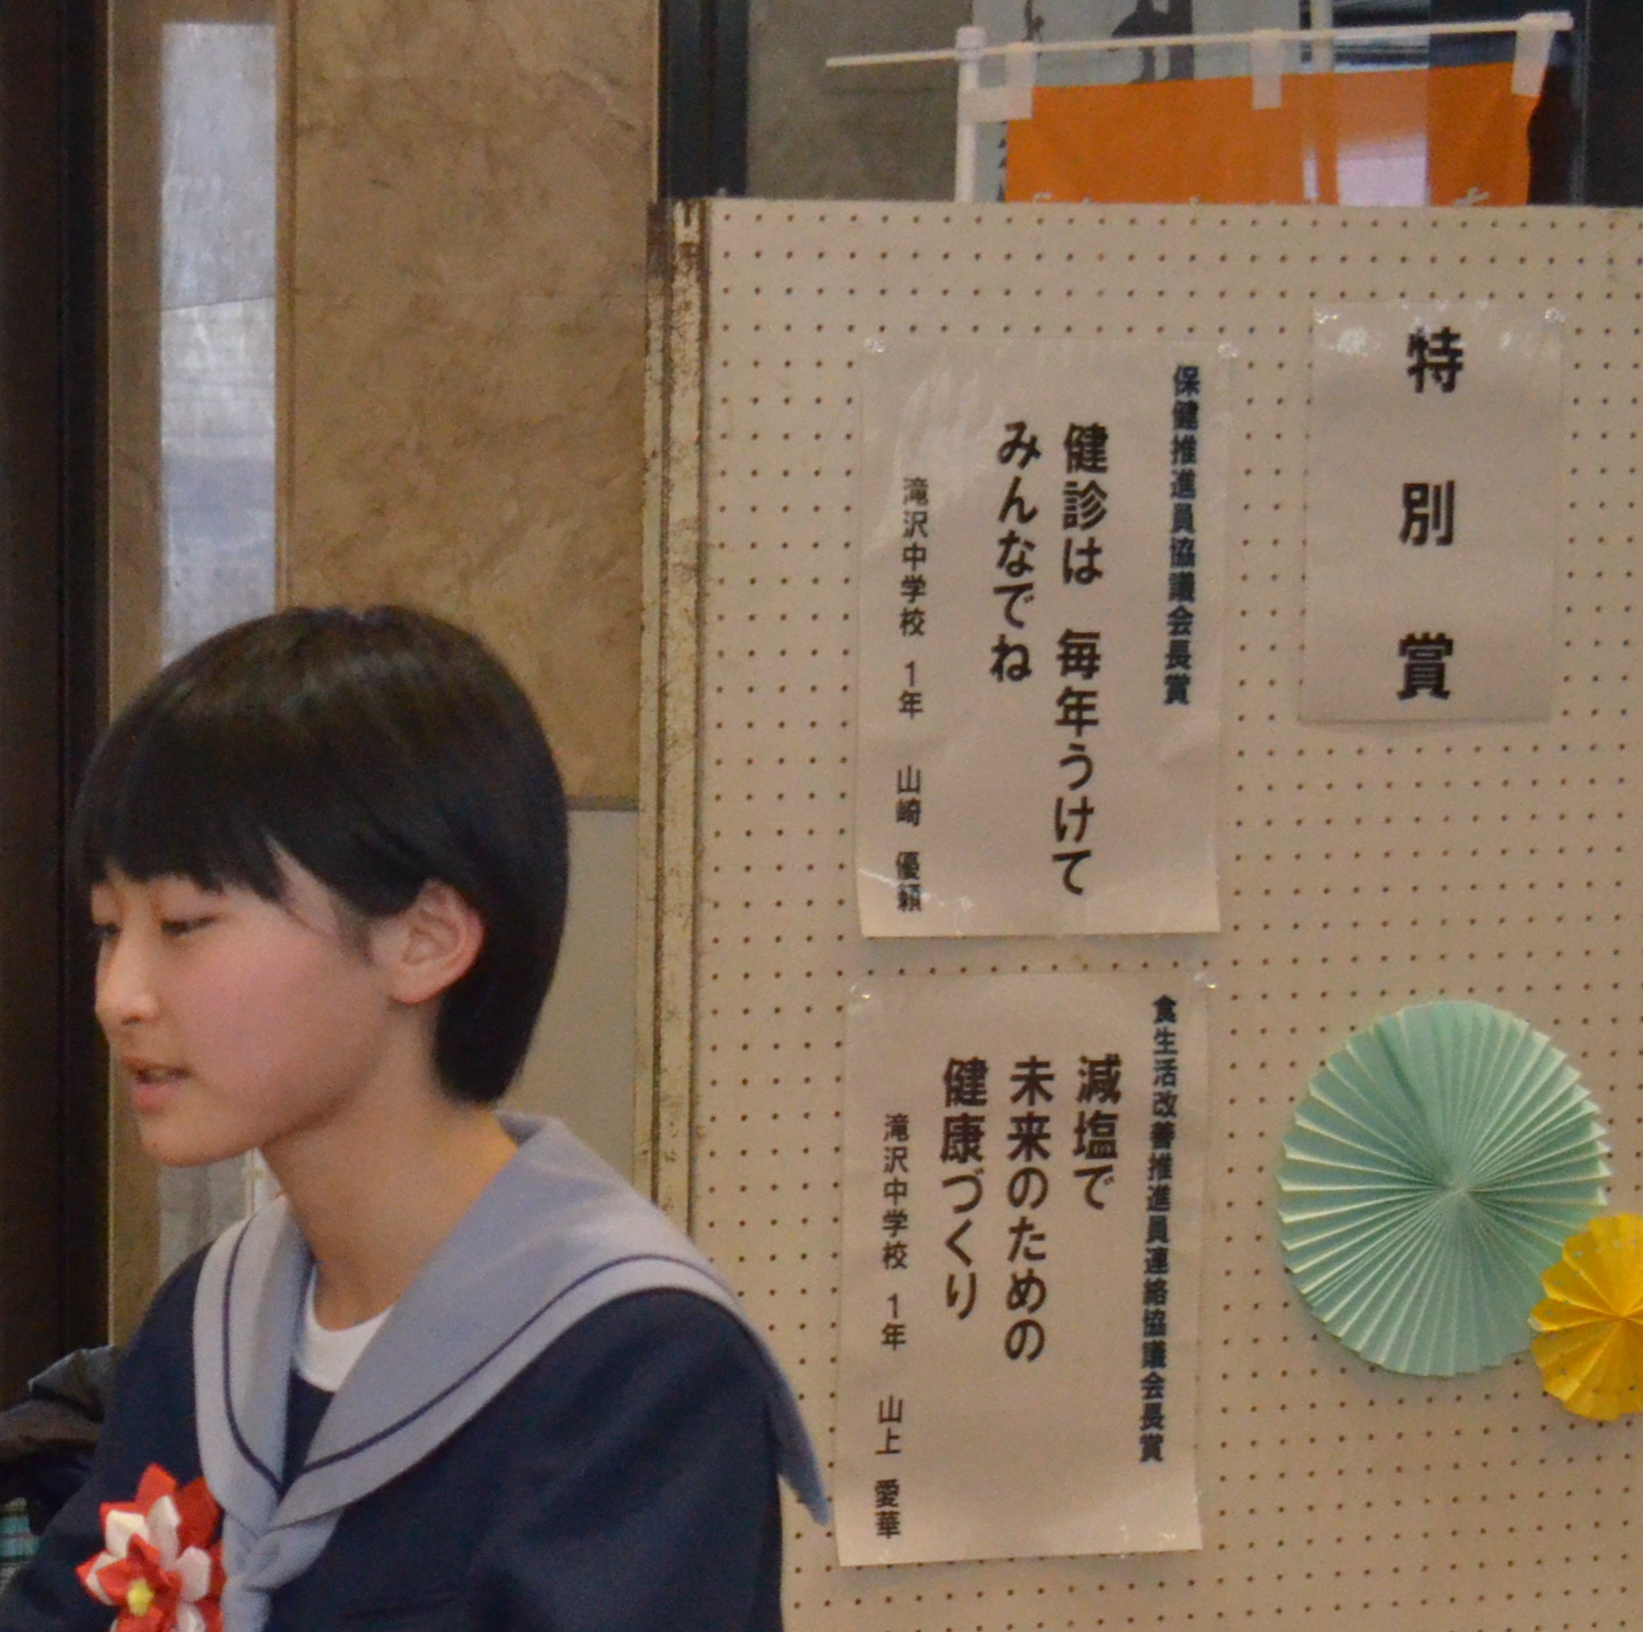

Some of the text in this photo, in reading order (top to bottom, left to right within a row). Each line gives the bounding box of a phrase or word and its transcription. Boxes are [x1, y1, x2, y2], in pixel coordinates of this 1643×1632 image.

[898, 476, 930, 637] 滝沢中学校
[989, 418, 1041, 684] みんなでね
[1050, 421, 1109, 897] 健診は 毎年うけて
[1163, 364, 1202, 707] 保健推進員協議会長賞
[1395, 326, 1465, 703] 特別賞
[898, 659, 925, 721] 1年
[939, 1056, 989, 1322] 健康づくり
[1004, 1055, 1056, 1365] 未来のための
[1073, 1055, 1124, 1212] 減塩で
[1139, 993, 1179, 1463] 食生活改善推進員連絡協議会長賞
[873, 1112, 911, 1540] 滝沢中学校 1年 山上 愛華
